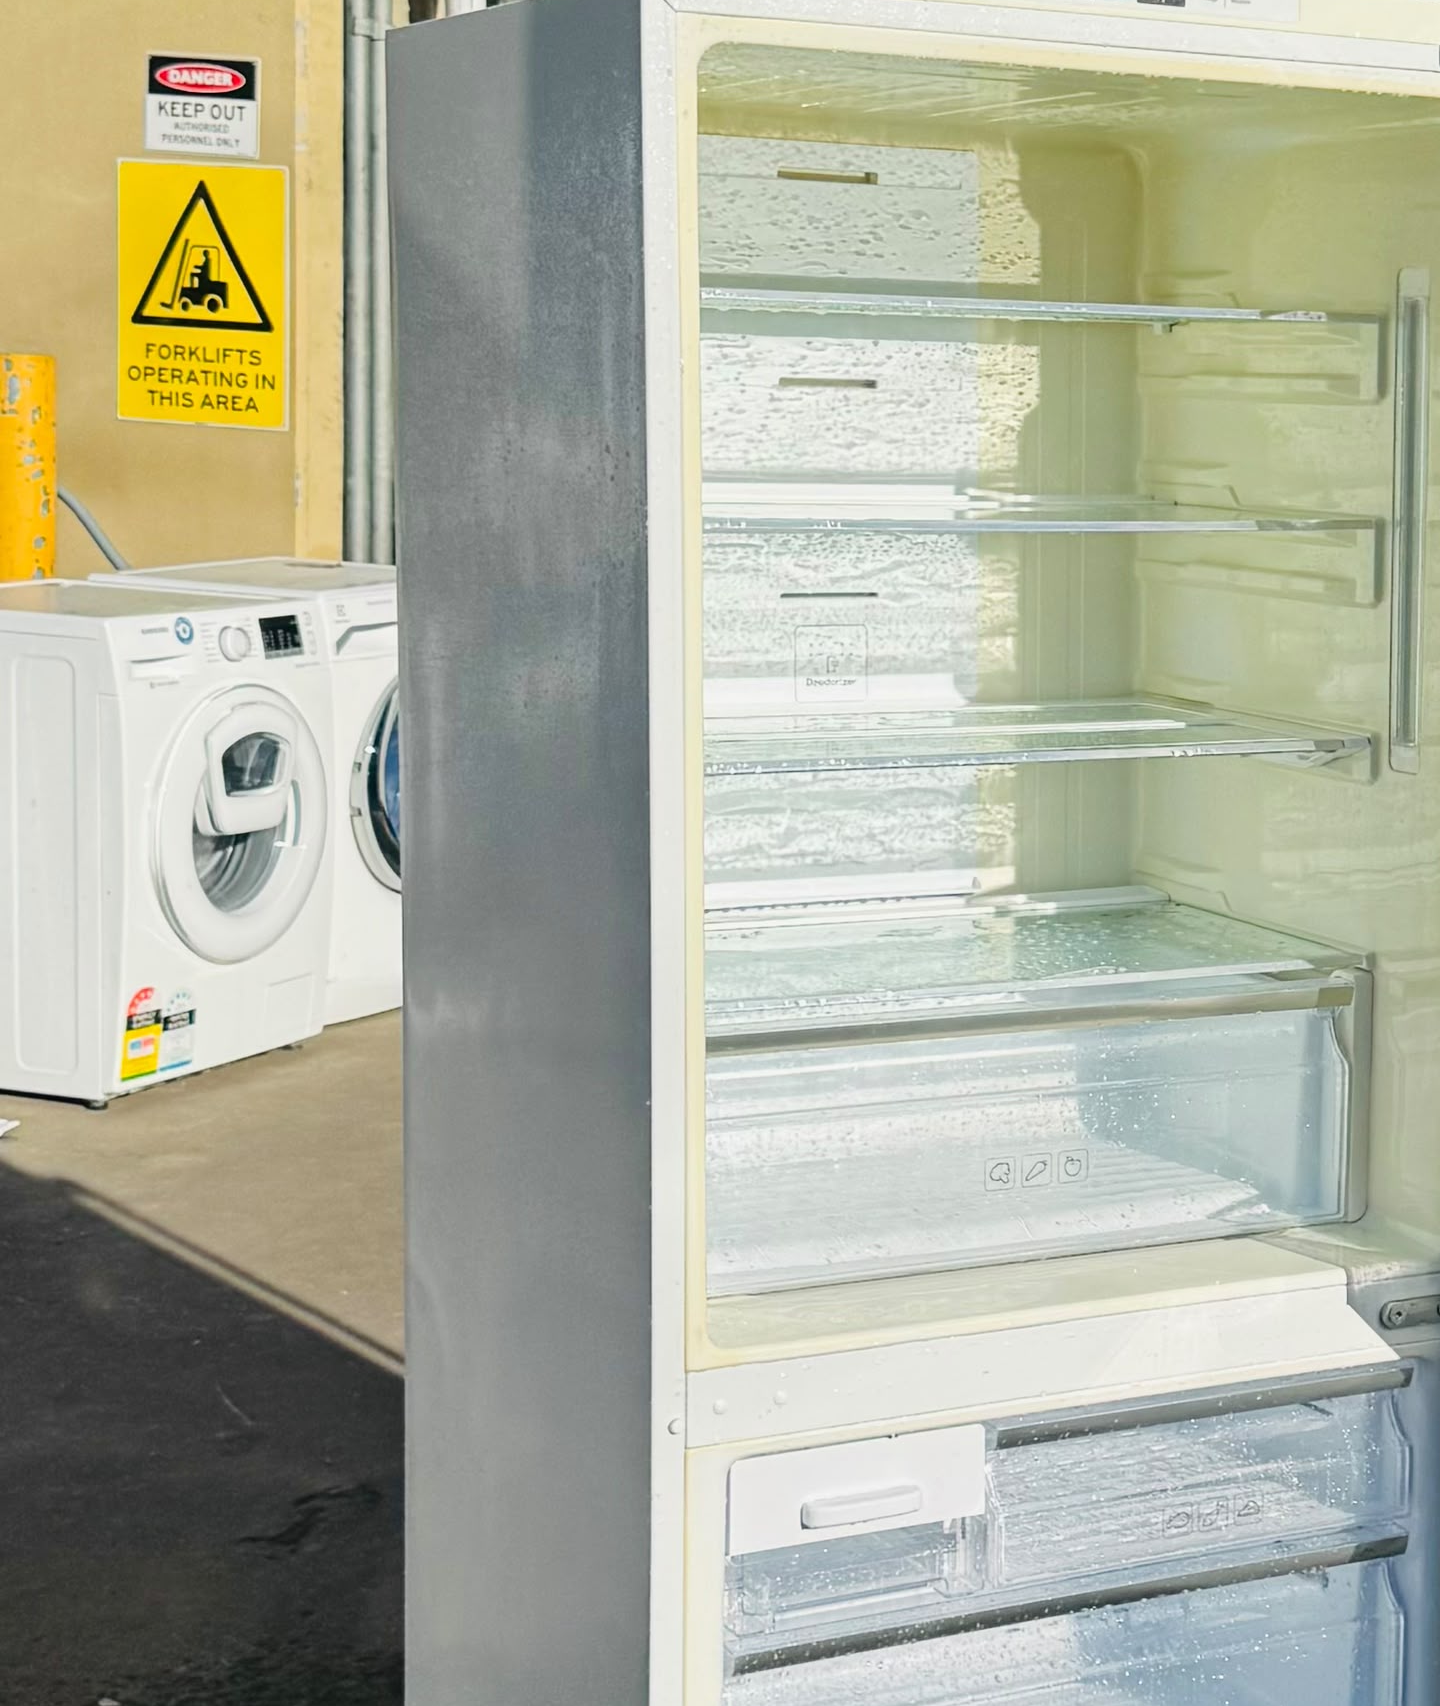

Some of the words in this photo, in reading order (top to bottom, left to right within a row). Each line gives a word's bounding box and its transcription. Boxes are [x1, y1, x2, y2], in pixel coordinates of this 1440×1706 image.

[168, 69, 233, 86] DANGER
[158, 101, 205, 118] KEEP
[210, 104, 247, 121] OUT
[173, 122, 230, 134] AUTHORISED
[161, 134, 213, 146] PERSONNEL
[216, 138, 240, 148] ONLY
[145, 343, 262, 366] FORKLIFTS
[127, 365, 248, 389] OPERATING
[255, 373, 276, 390] IN
[147, 389, 194, 408] THIS
[200, 393, 259, 413] AREA
